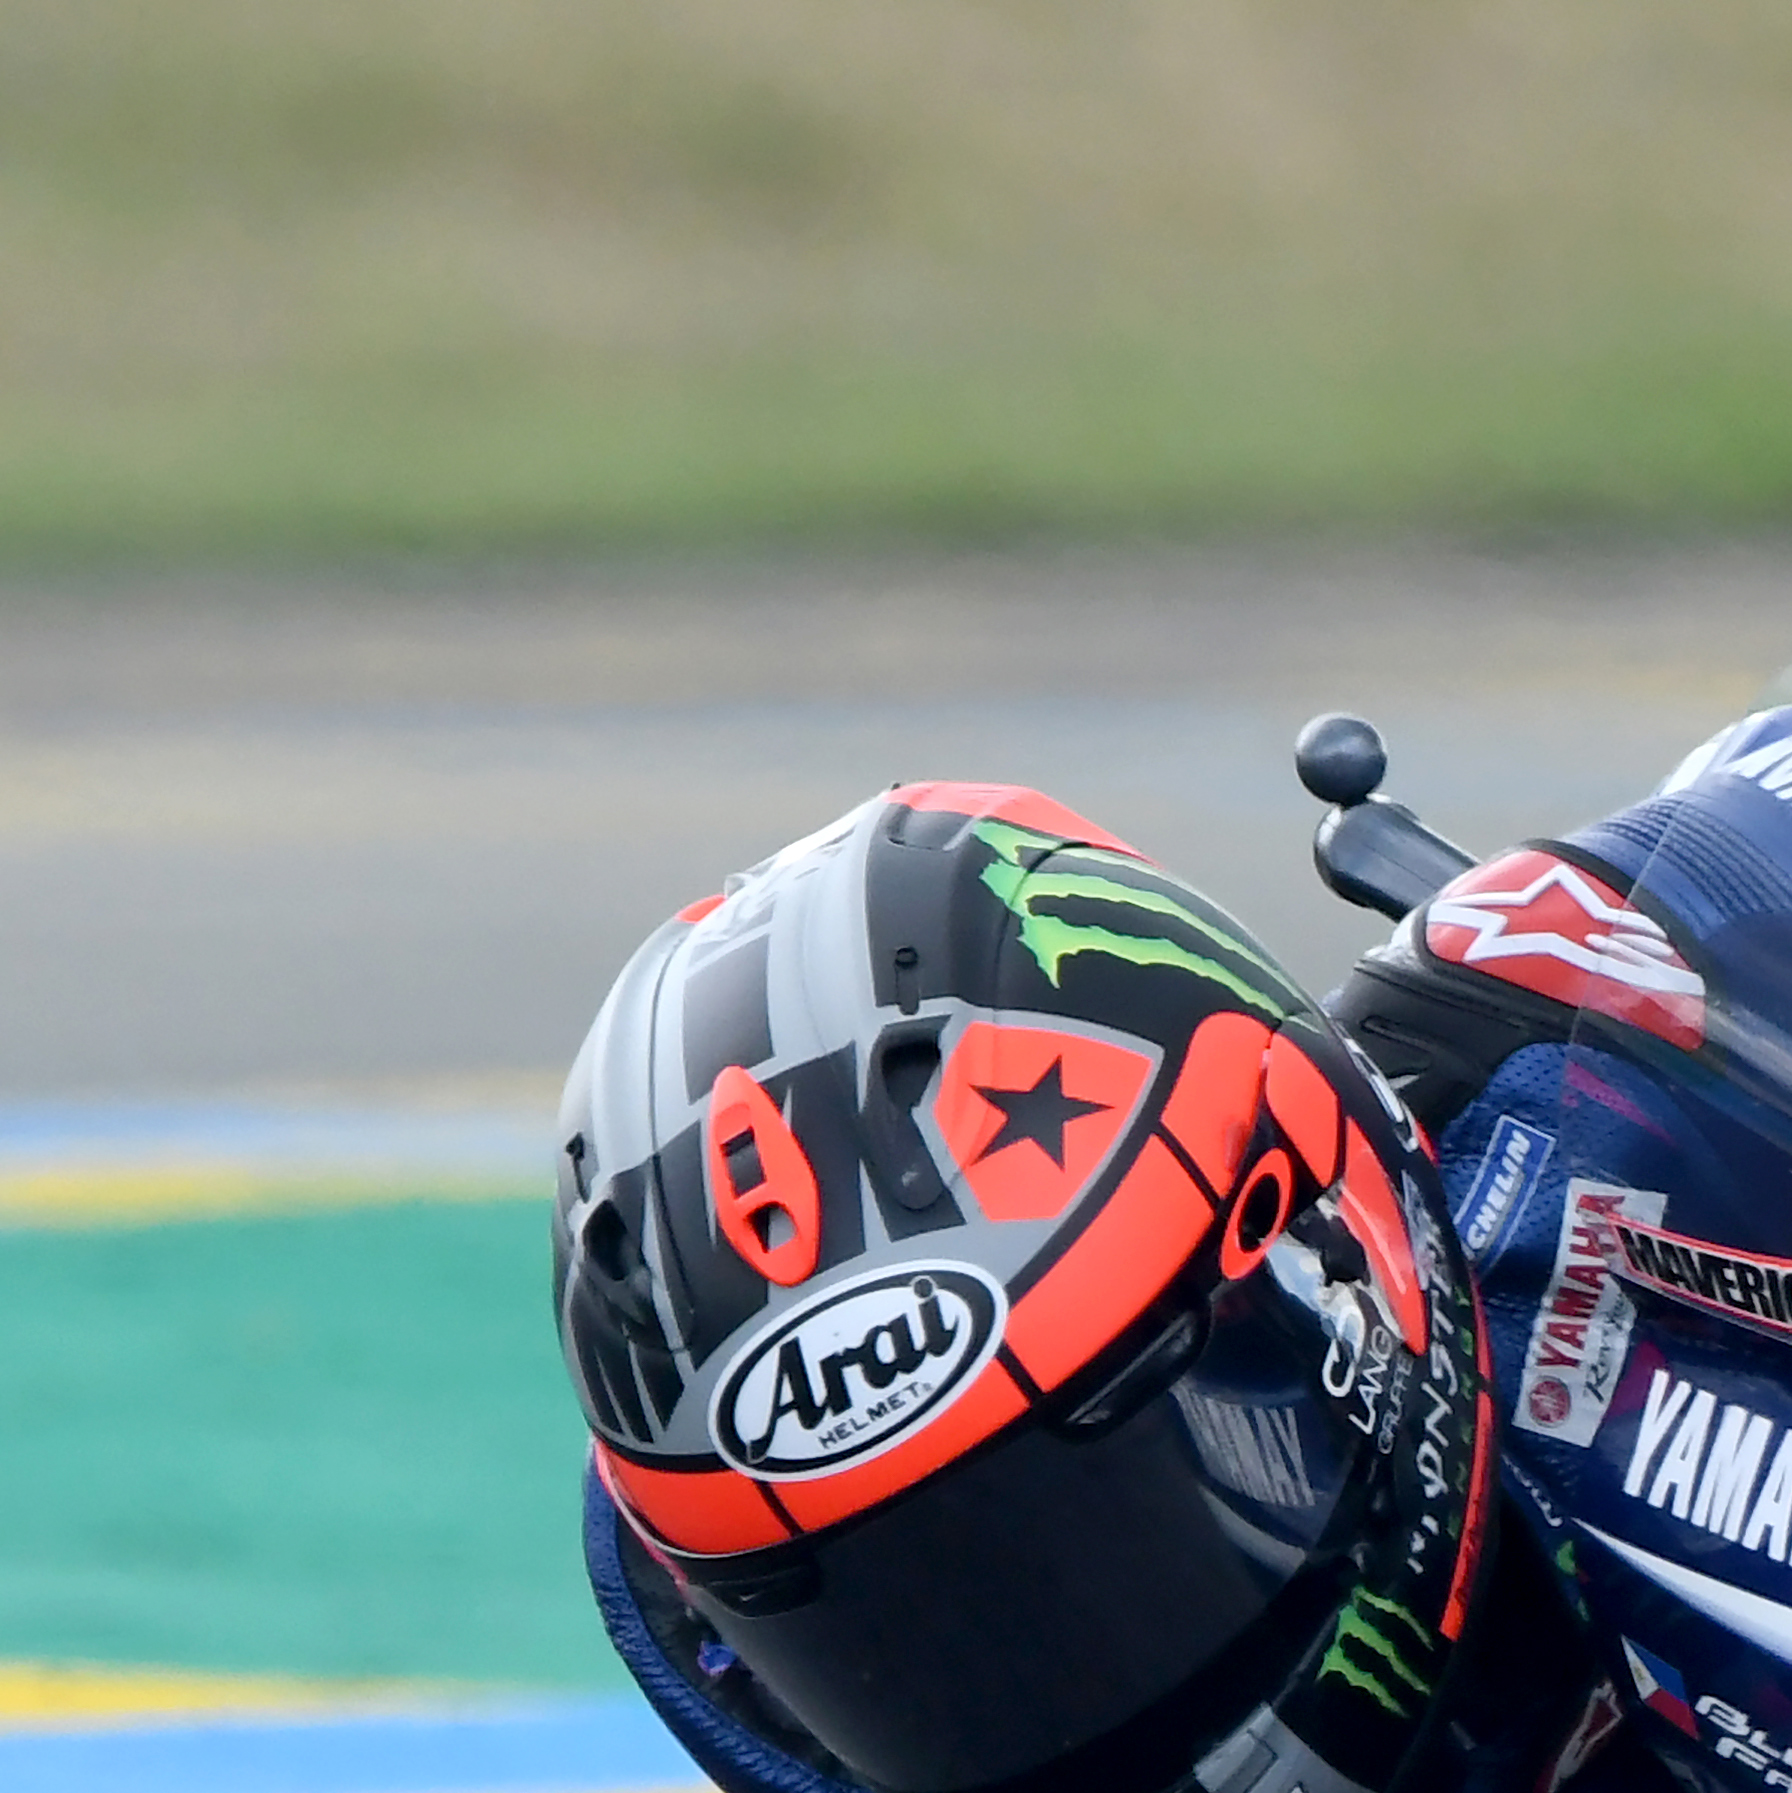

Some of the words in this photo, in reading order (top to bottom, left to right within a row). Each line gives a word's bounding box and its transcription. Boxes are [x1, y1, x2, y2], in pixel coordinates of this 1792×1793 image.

[1461, 1130, 1532, 1256] ICHELIN
[1537, 1194, 1625, 1369] YAMAHA
[746, 1275, 960, 1464] Arai
[818, 1382, 921, 1450] HELMET
[1347, 1324, 1392, 1434] LANG
